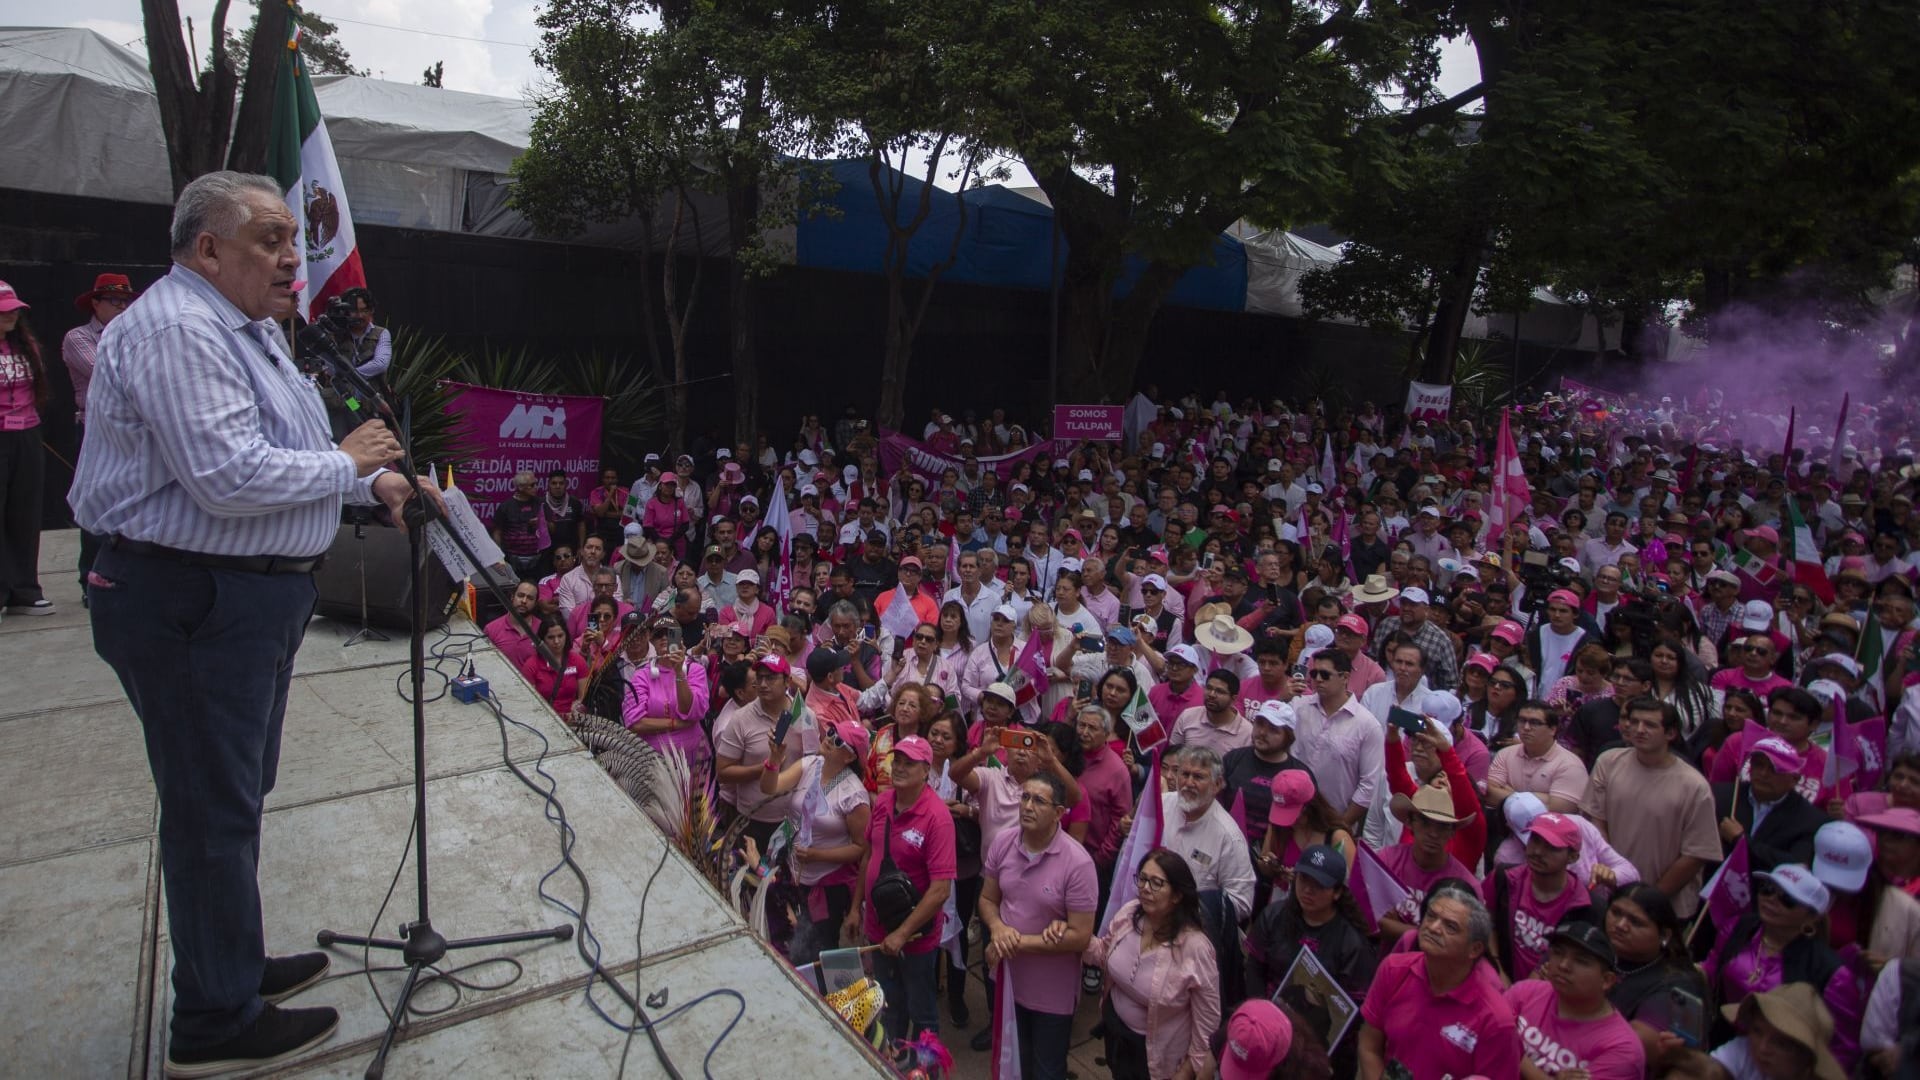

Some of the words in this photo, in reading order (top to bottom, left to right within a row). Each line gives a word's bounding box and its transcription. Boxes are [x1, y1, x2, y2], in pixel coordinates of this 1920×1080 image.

[1070, 410, 1107, 418] SOMOS
[1065, 421, 1112, 430] TLALPAN
[516, 460, 561, 473] BENITO
[474, 478, 516, 493] SOMO
